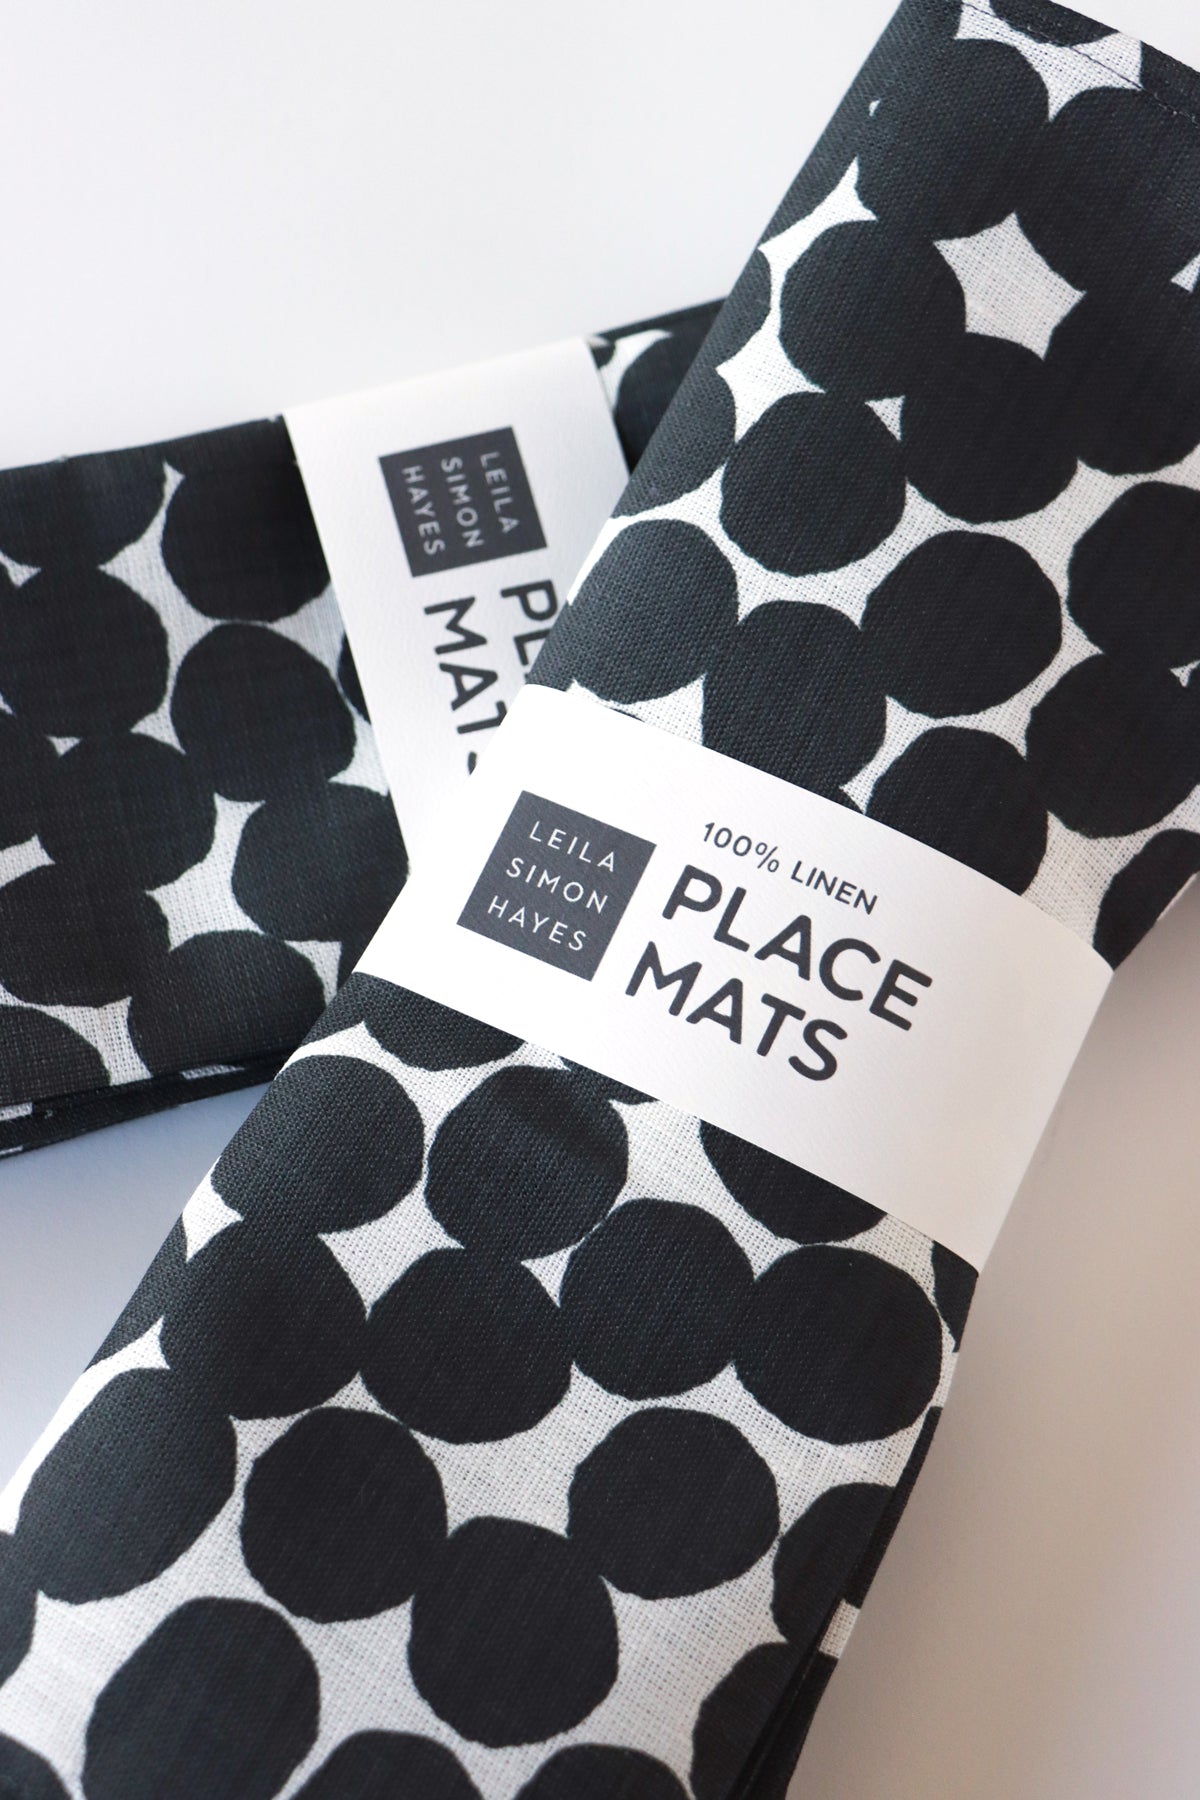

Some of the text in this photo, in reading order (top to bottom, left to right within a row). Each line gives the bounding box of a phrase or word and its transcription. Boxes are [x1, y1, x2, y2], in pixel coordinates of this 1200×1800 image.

[402, 465, 445, 556] HAYES
[441, 456, 484, 548] SIMON
[480, 452, 519, 533] LEILA
[423, 596, 507, 774] MAT
[506, 857, 608, 914] SIMON
[529, 821, 616, 872] LEILA
[703, 822, 878, 916] 100% LINEN
[487, 895, 587, 952] HAYES
[662, 864, 933, 1031] PLACE
[625, 941, 848, 1081] MATS
